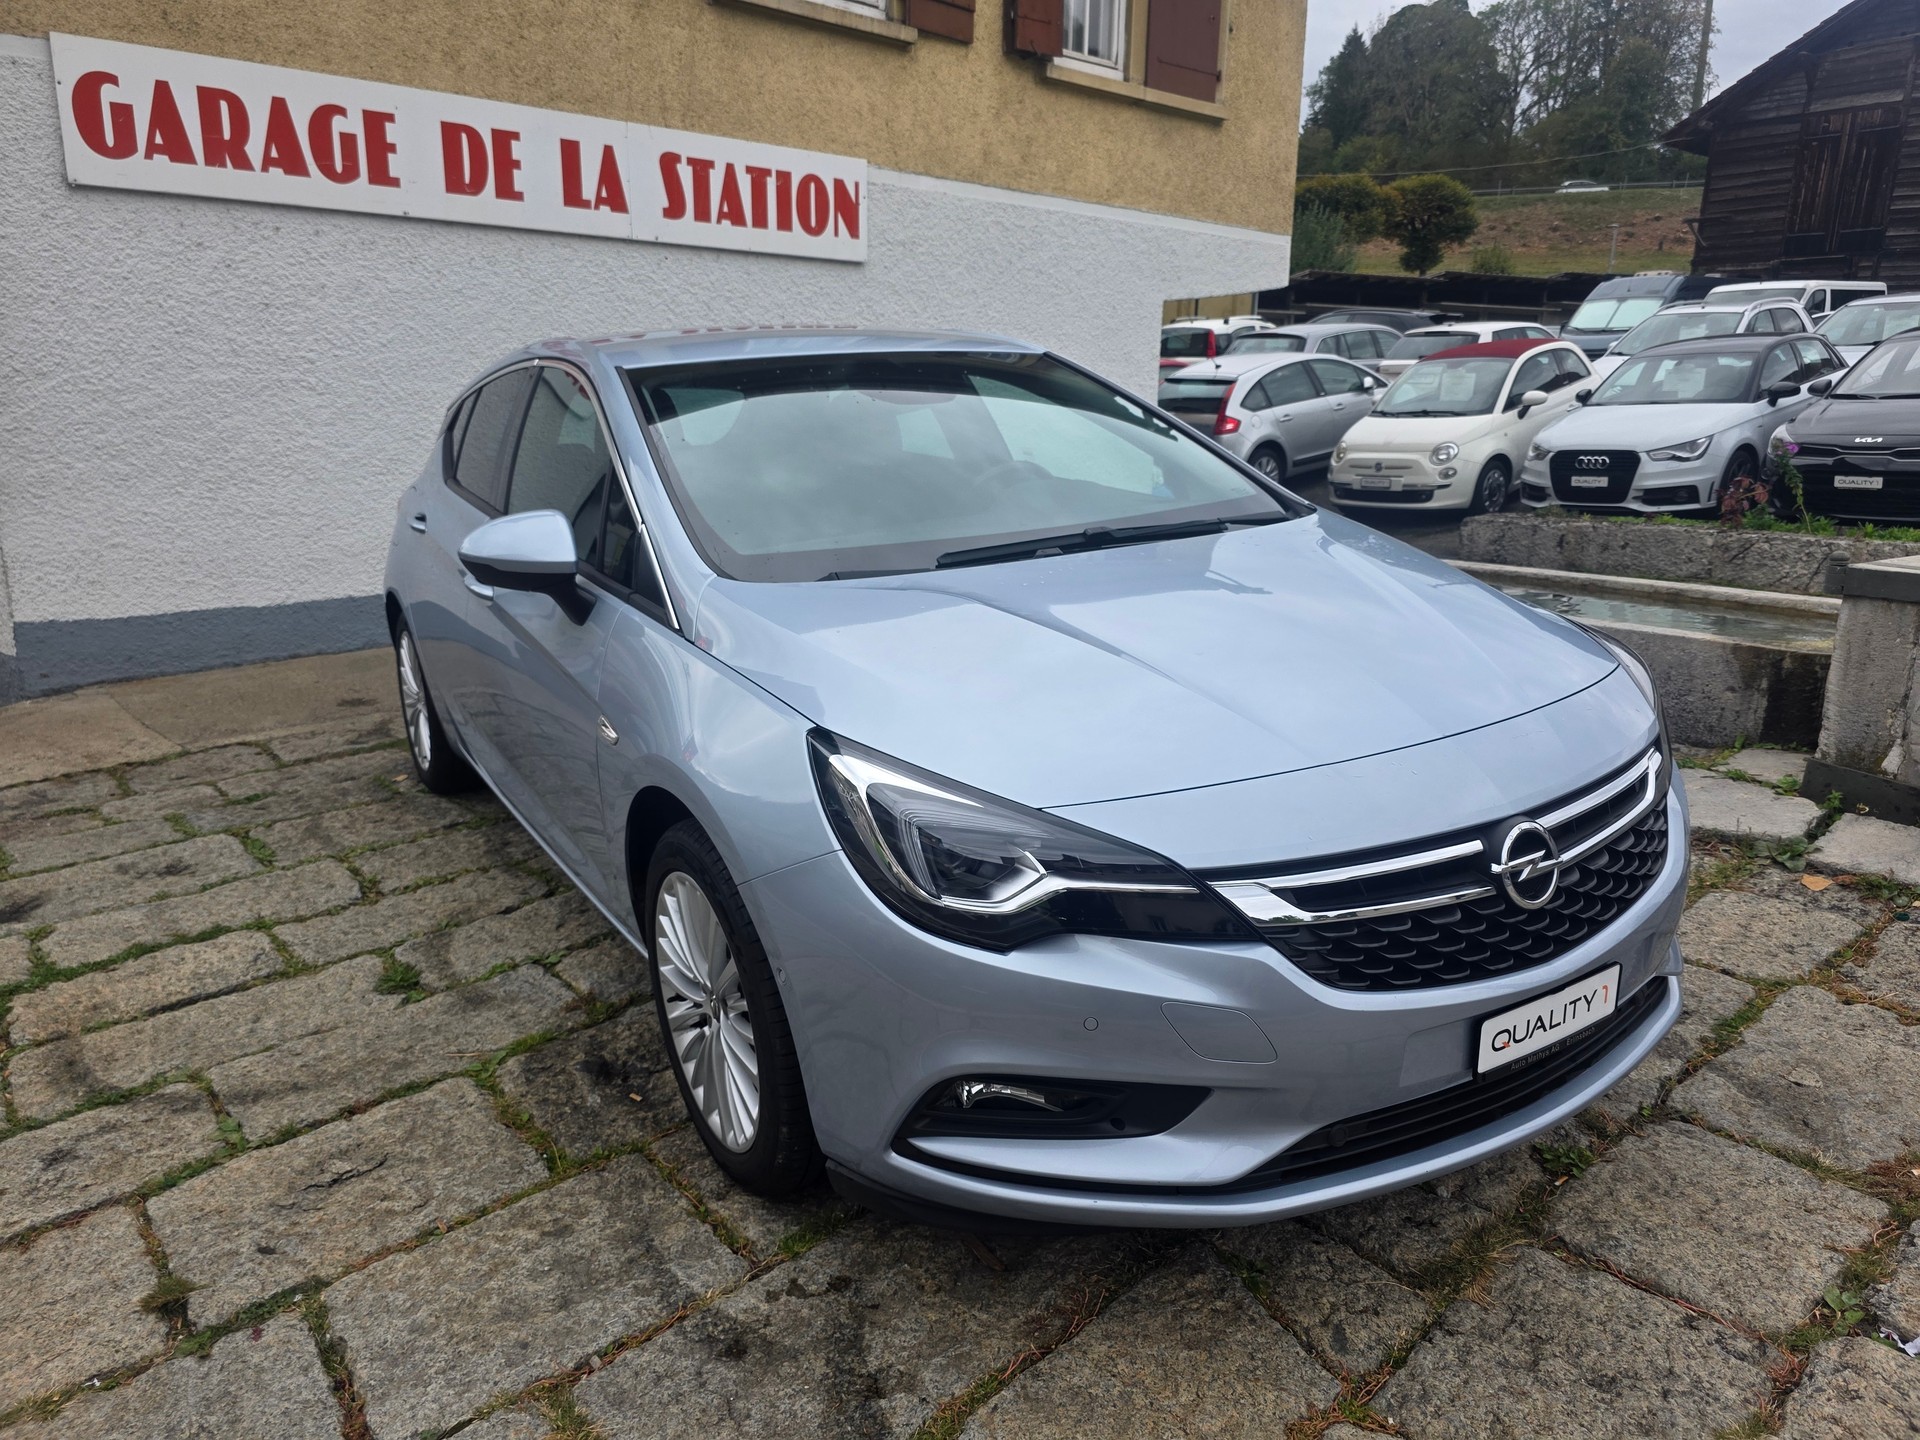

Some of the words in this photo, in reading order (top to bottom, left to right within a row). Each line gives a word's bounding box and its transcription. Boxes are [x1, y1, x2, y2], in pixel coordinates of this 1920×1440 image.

[71, 70, 400, 188] GARAGE
[440, 121, 523, 202] DE
[560, 139, 628, 214] LA
[659, 152, 860, 240] STATION
[1491, 989, 1598, 1052] QUALITY
[1510, 1060, 1526, 1070] Auto
[1551, 1044, 1560, 1054] AG
